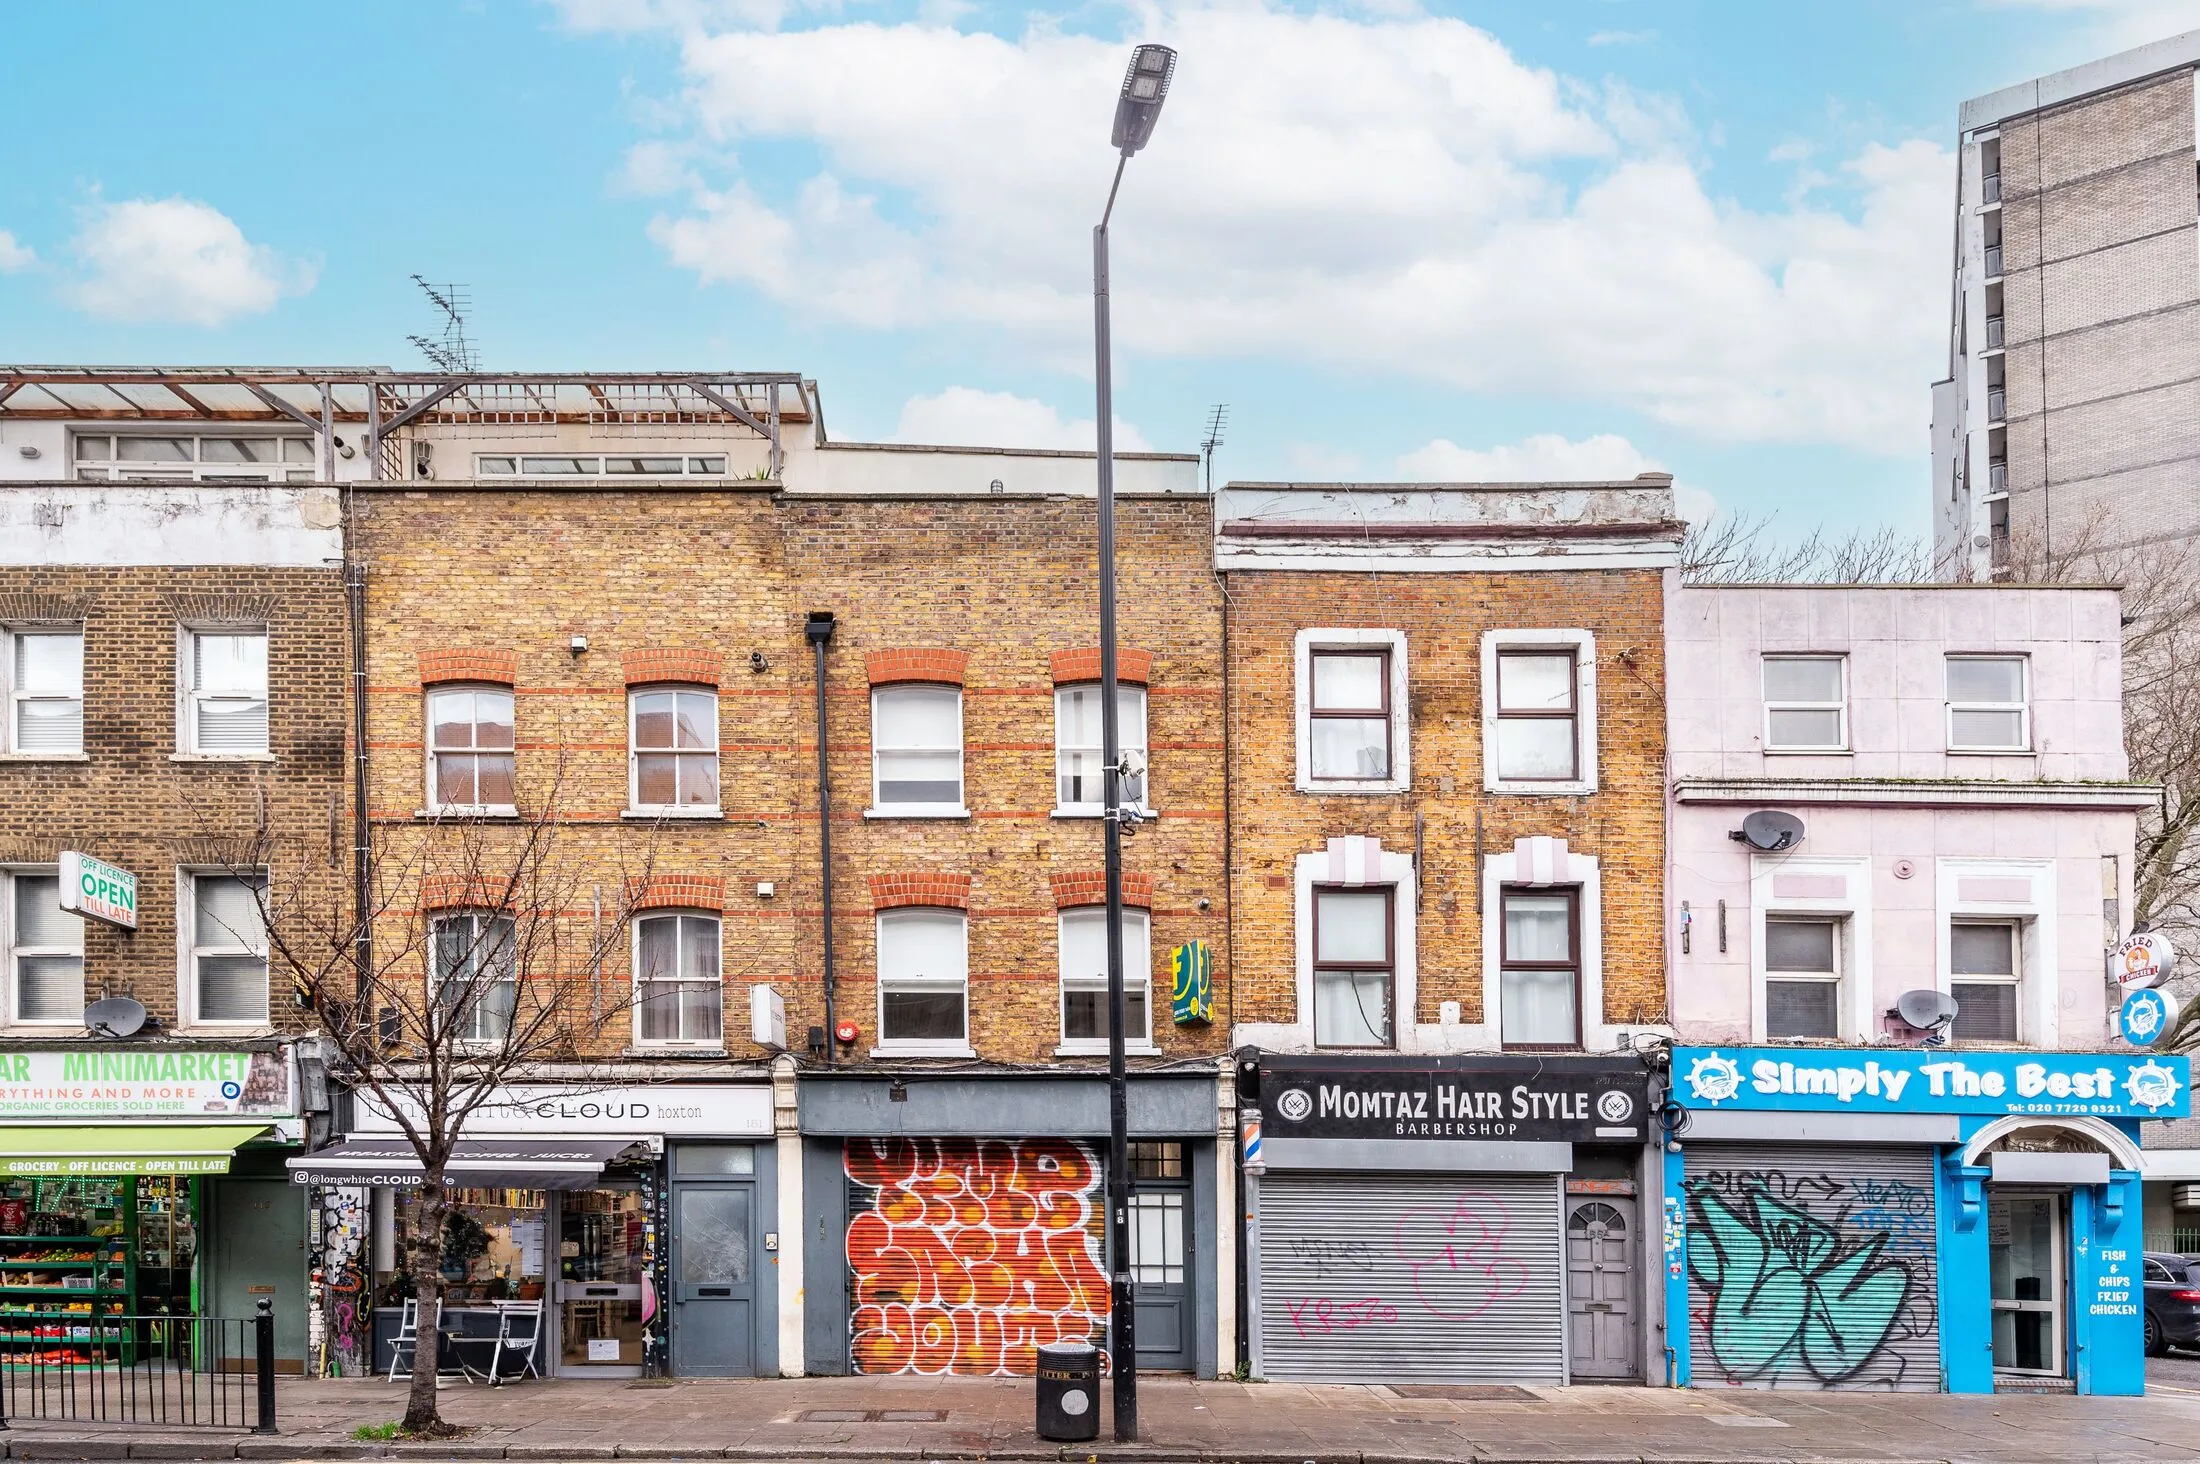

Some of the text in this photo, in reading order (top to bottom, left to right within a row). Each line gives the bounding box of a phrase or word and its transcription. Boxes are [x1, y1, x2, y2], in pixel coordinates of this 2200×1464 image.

[81, 858, 134, 887] OFF LICENCE
[81, 873, 133, 910] OPEN
[84, 896, 133, 923] TILL LATE
[2120, 937, 2153, 956] FRIED
[63, 1053, 249, 1081] MINIMARKET
[1919, 1062, 2006, 1098] The
[2016, 1063, 2116, 1098] Best
[91, 1088, 132, 1099] AND
[143, 1088, 196, 1098] MORE
[55, 1101, 119, 1111] GROCERIES
[123, 1101, 153, 1110] SOLD
[157, 1101, 186, 1110] HERE
[2006, 1103, 2026, 1113] Tel:
[2028, 1103, 2053, 1113] 020
[657, 1105, 702, 1119] hoxton
[1396, 1123, 1518, 1136] BARBERSHOP
[529, 1152, 594, 1160] JUICES
[9, 1161, 59, 1172] GROCERY
[69, 1161, 89, 1171] OFF
[91, 1161, 137, 1171] LICENCE
[146, 1161, 175, 1171] OPEN
[178, 1160, 199, 1171] TILL
[202, 1160, 227, 1171] LATE
[2101, 1250, 2127, 1261] FISH
[2109, 1263, 2119, 1274] &
[2098, 1276, 2131, 1287] CHIPS
[2097, 1291, 2129, 1302] FRIED
[2090, 1304, 2137, 1315] CHICKEN
